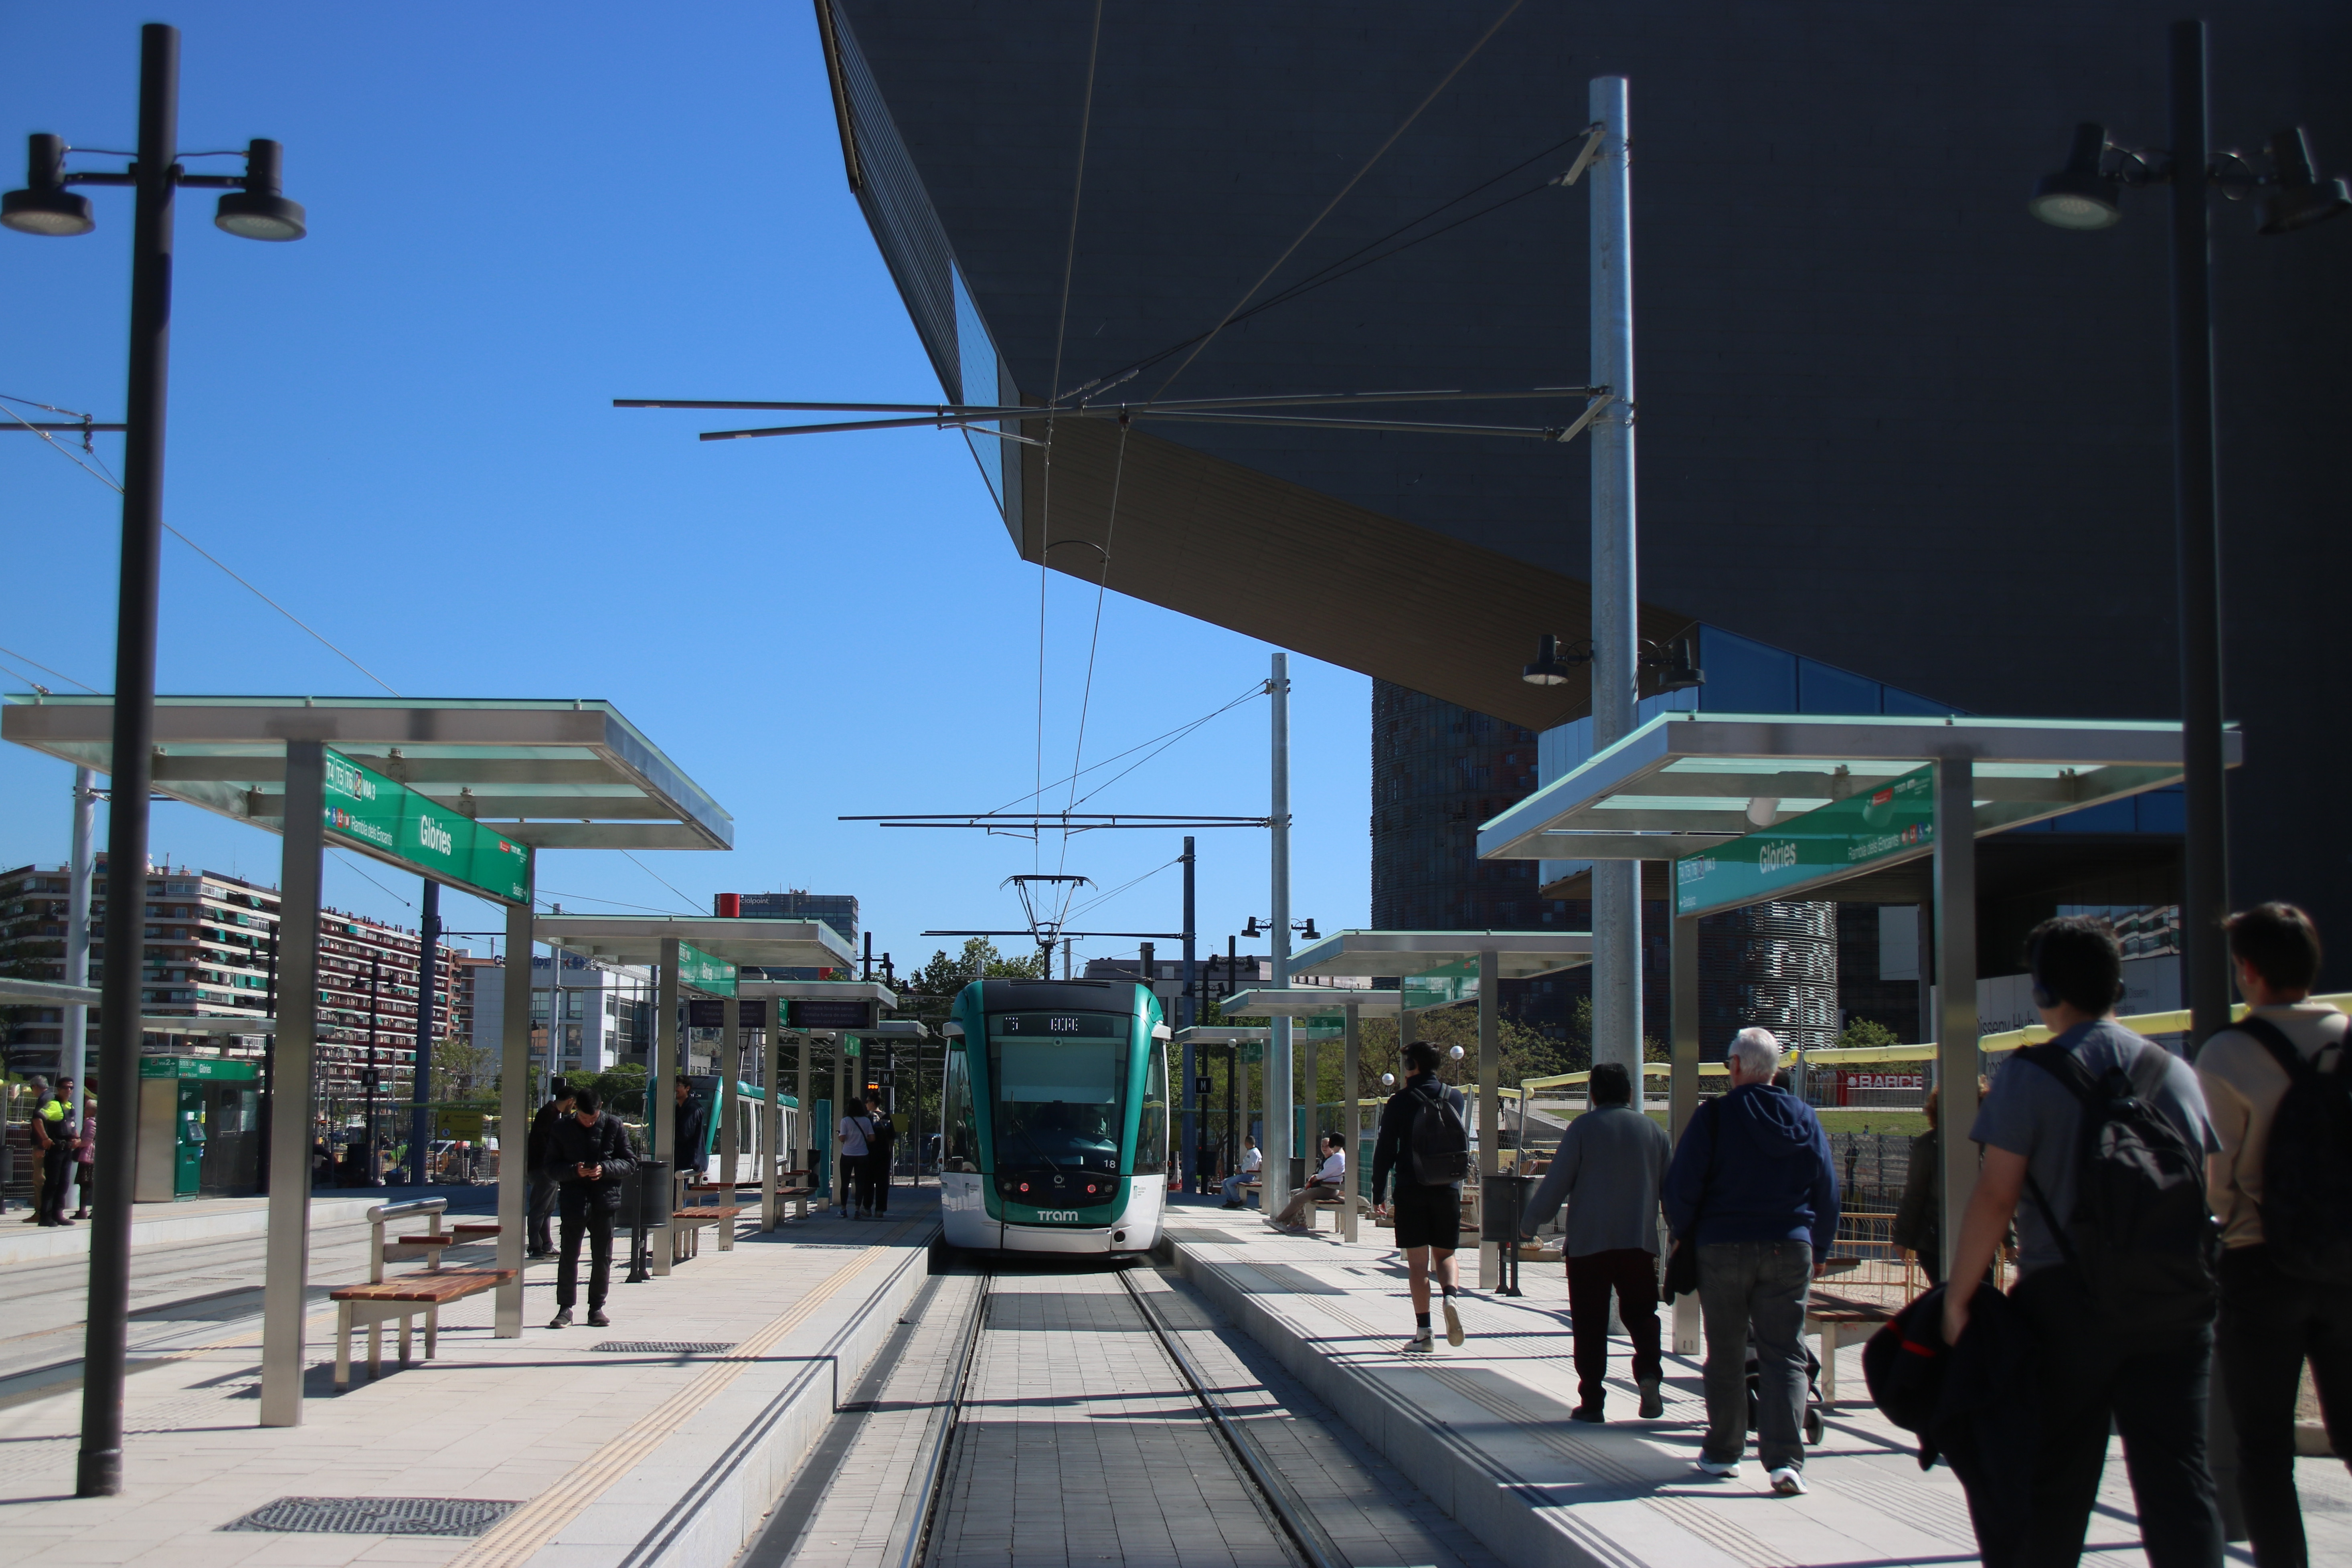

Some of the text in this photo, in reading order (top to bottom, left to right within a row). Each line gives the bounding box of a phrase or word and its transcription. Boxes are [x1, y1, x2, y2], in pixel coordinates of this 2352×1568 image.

[327, 762, 376, 801] T4 T5 T6 VIA 3
[352, 815, 368, 836] Rambla
[368, 823, 377, 840] dels
[377, 826, 393, 846] Encants
[421, 815, 451, 856] Glòries
[1759, 840, 1797, 874] Glòries
[1848, 844, 1866, 860] Rambla
[1868, 840, 1877, 855] dels
[368, 1073, 373, 1083] M
[884, 1074, 889, 1083] M
[1201, 1080, 1206, 1091] M
[1104, 1159, 1116, 1169] 18
